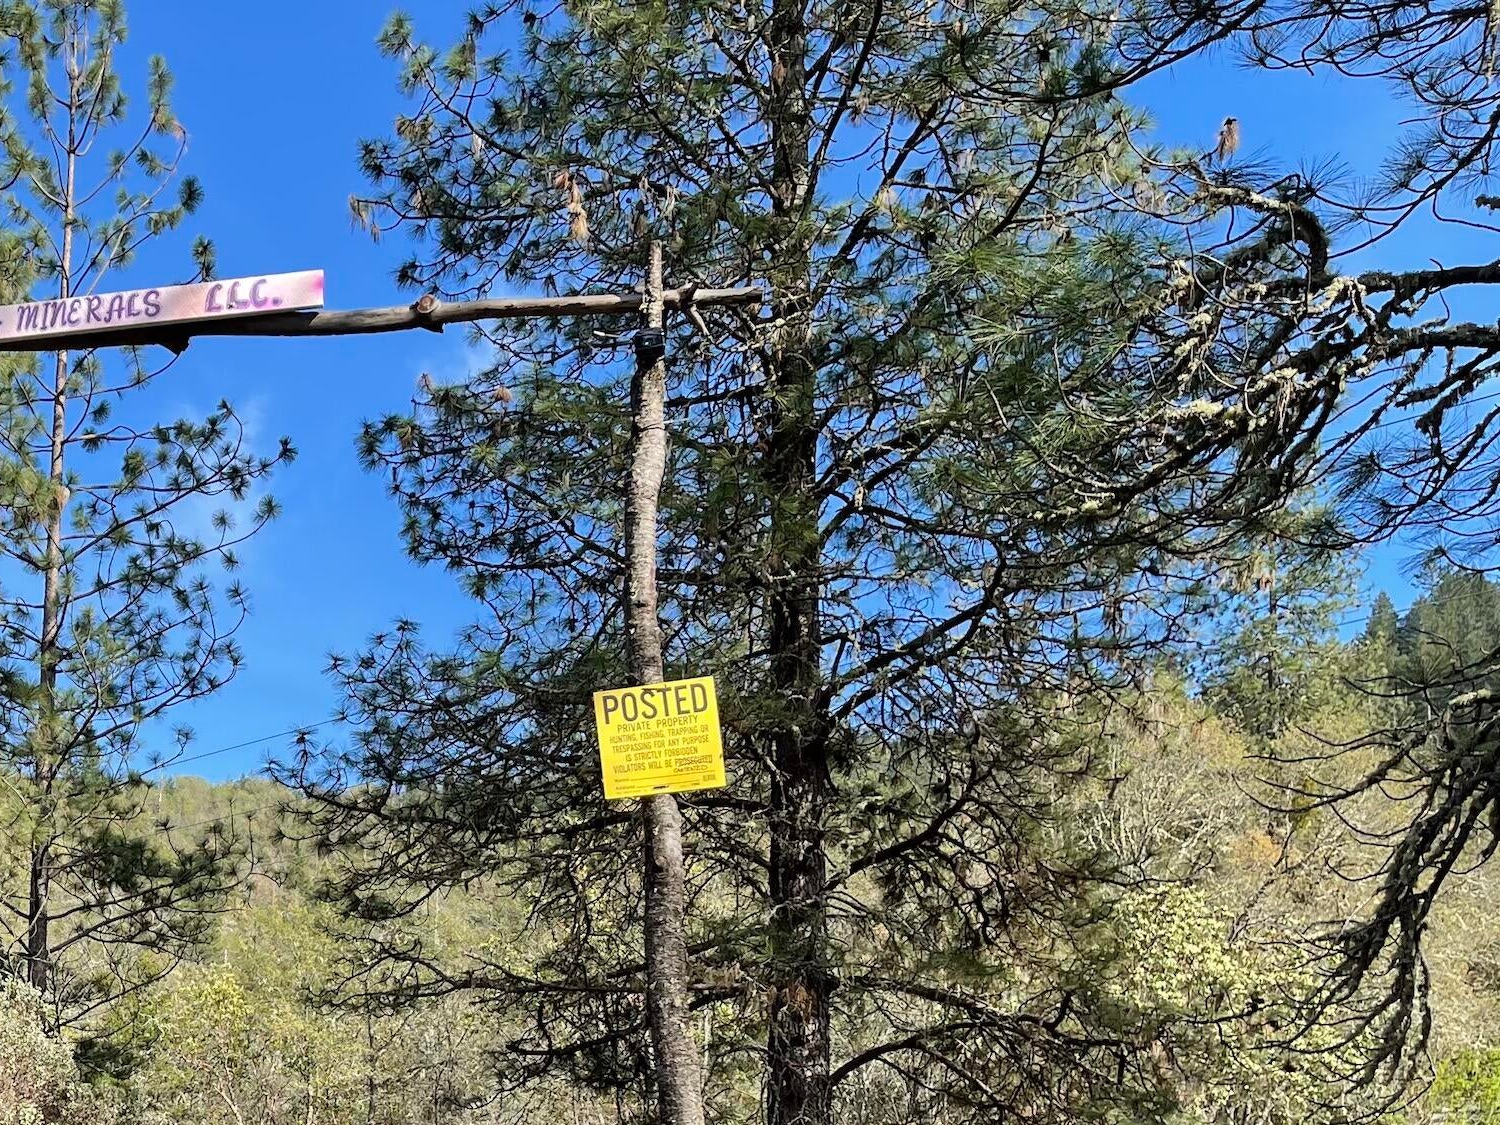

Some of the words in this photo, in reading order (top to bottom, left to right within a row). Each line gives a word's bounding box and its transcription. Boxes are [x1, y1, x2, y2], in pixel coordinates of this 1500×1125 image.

[16, 290, 162, 332] MINERALS
[602, 683, 708, 725] POSTED
[617, 720, 651, 733] PRIVATE
[657, 715, 698, 728] PROPERTY
